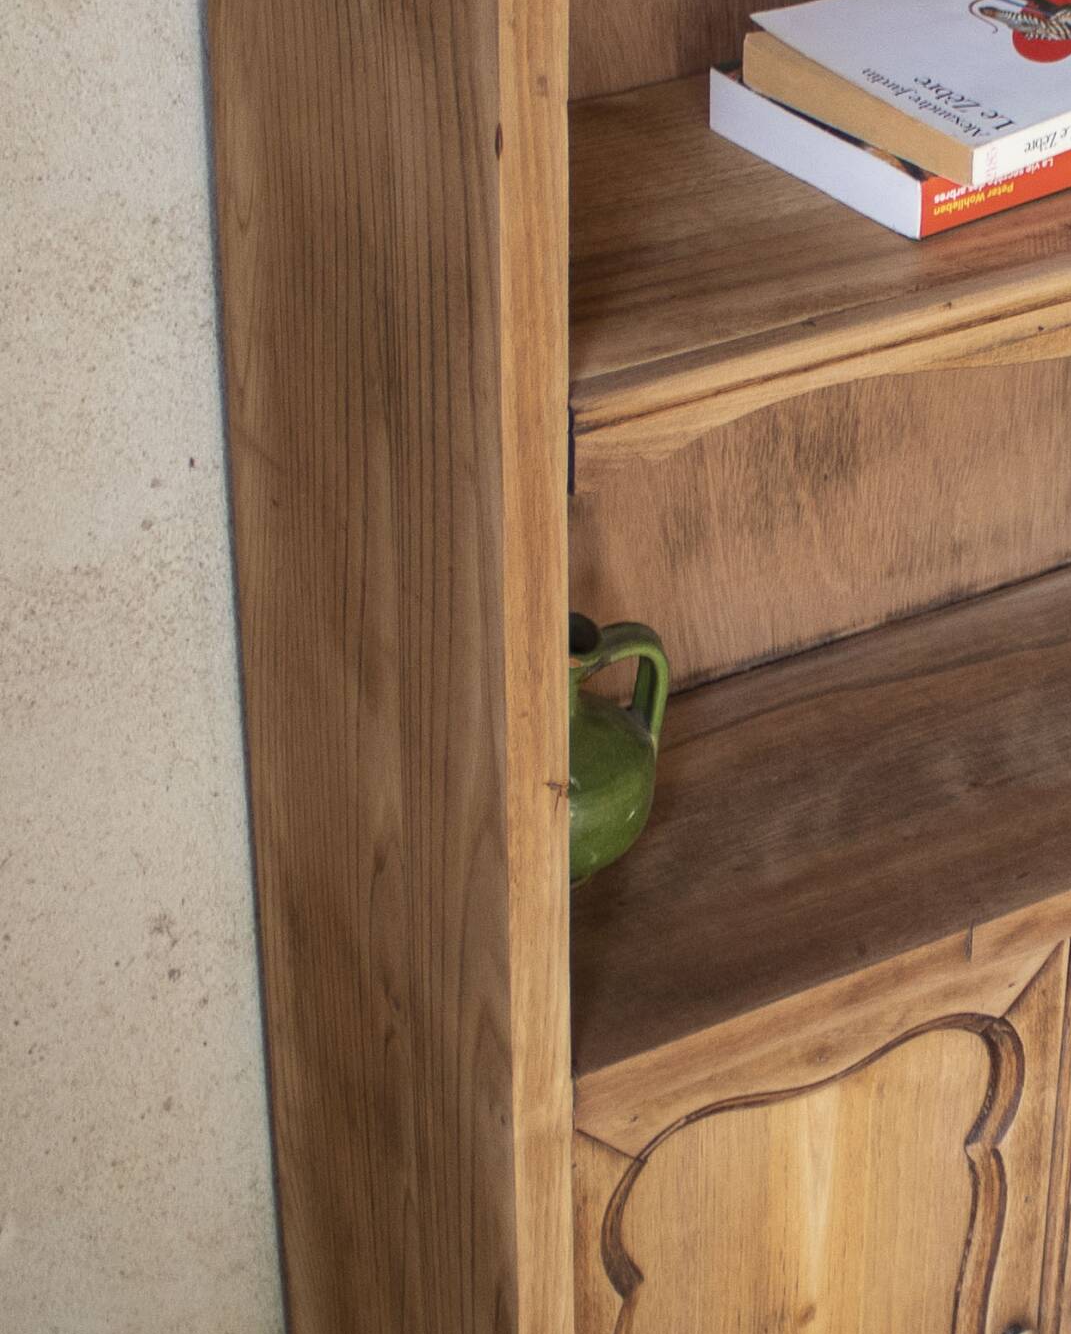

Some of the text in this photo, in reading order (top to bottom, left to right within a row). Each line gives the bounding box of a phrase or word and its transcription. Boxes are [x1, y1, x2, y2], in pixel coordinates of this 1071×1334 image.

[914, 76, 1015, 130] Le Zèbre
[1024, 131, 1057, 153] Zèbre
[934, 182, 1014, 216] Peter Wohlleben
